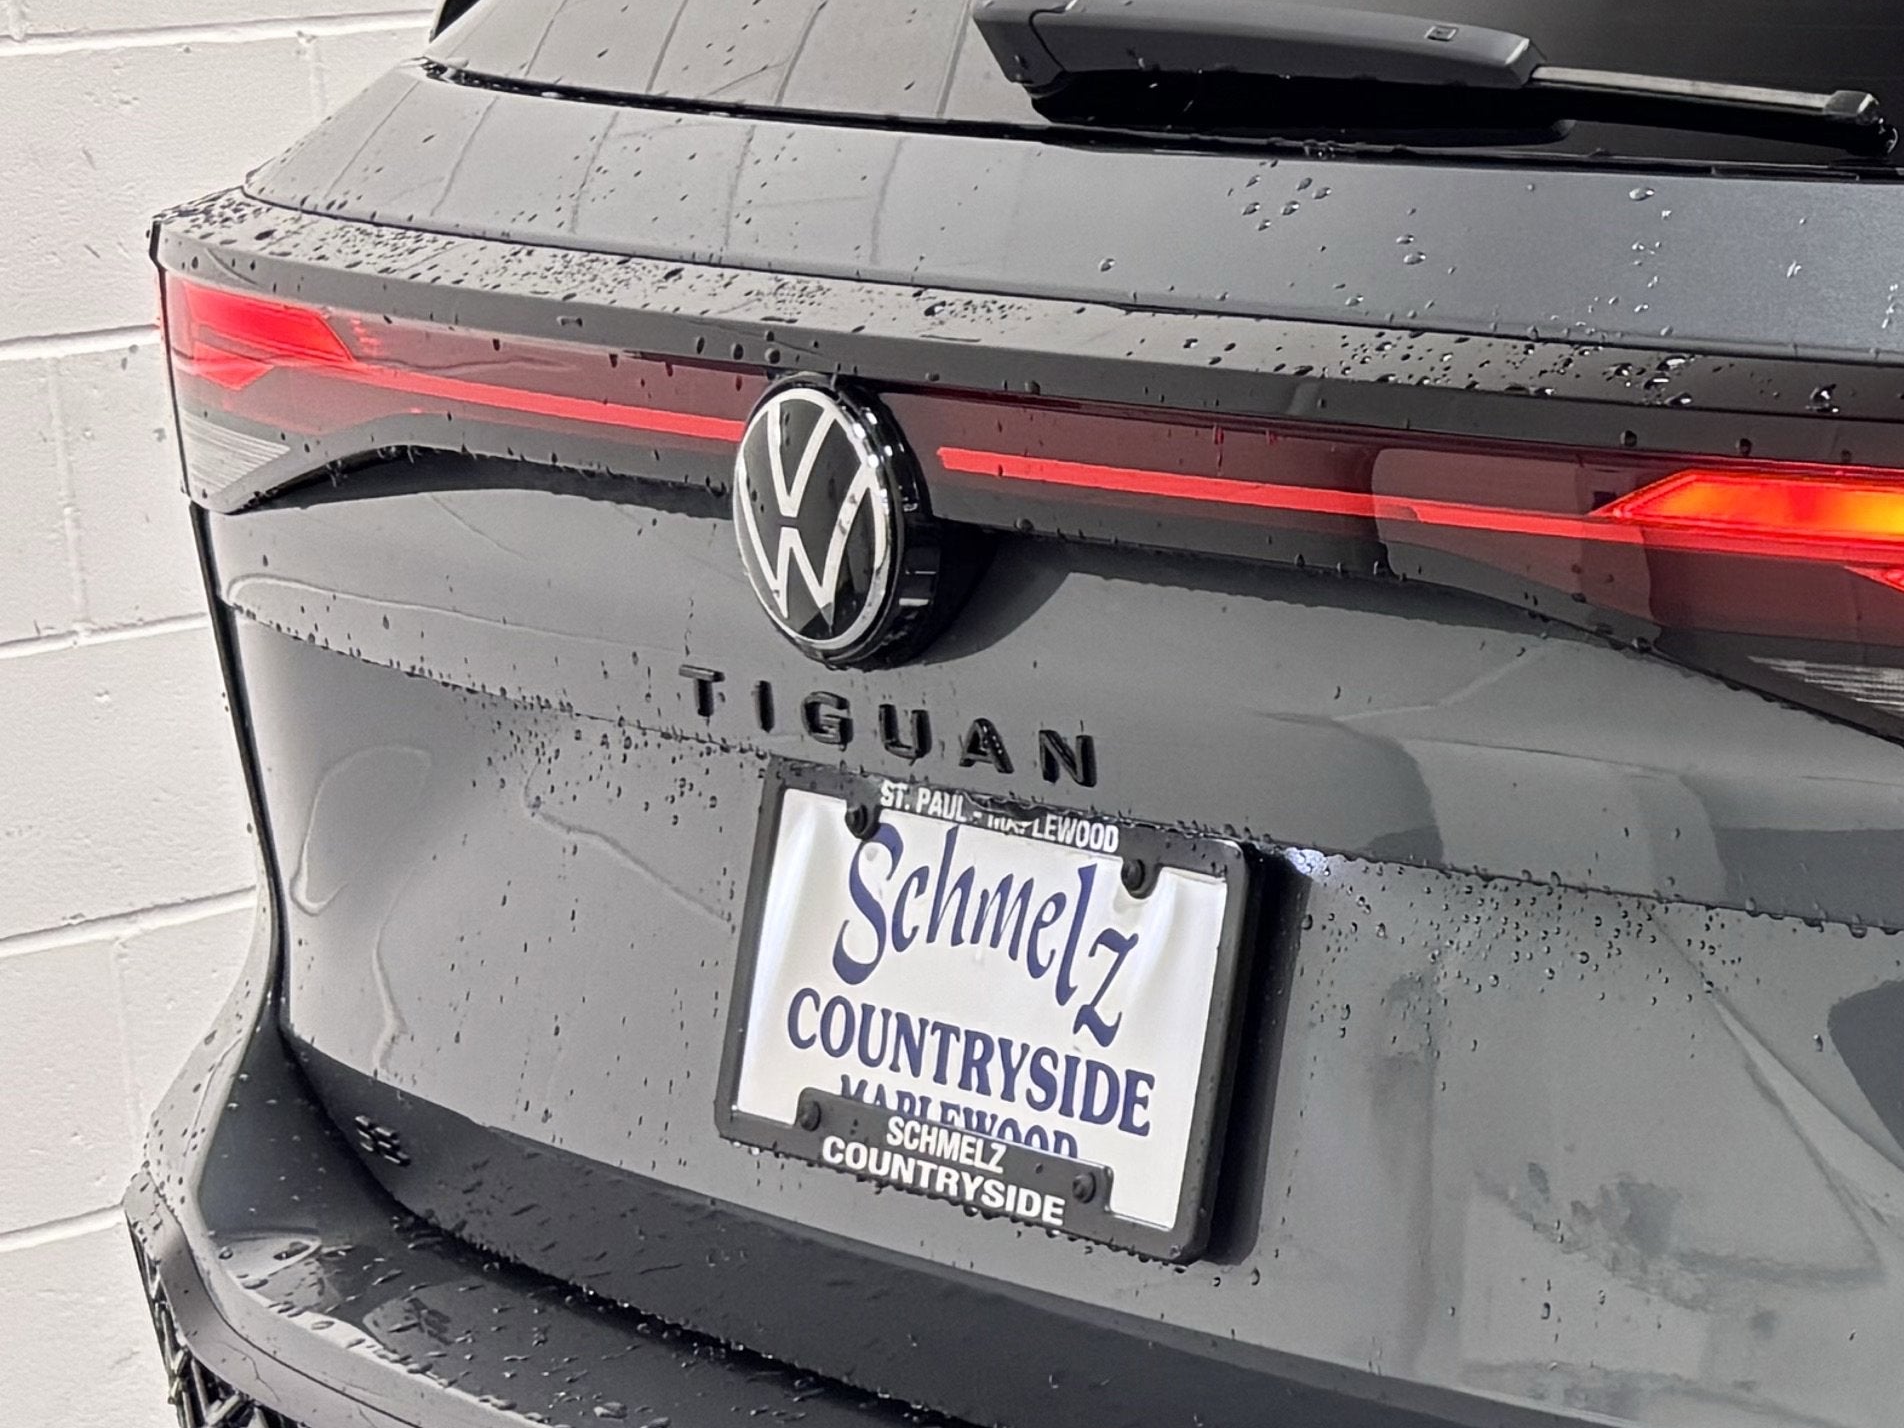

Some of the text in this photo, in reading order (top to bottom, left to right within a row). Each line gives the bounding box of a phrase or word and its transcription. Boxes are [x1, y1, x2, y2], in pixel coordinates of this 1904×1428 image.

[679, 664, 1097, 787] TIGUAN
[880, 779, 910, 810] ST.
[915, 787, 967, 822] PAUL
[832, 822, 1139, 1047] Schmelz
[788, 988, 1156, 1137] COUNTRYSIDE
[822, 1135, 1066, 1227] COUNTRYSIDE
[886, 1115, 1008, 1174] SCHMELZ
